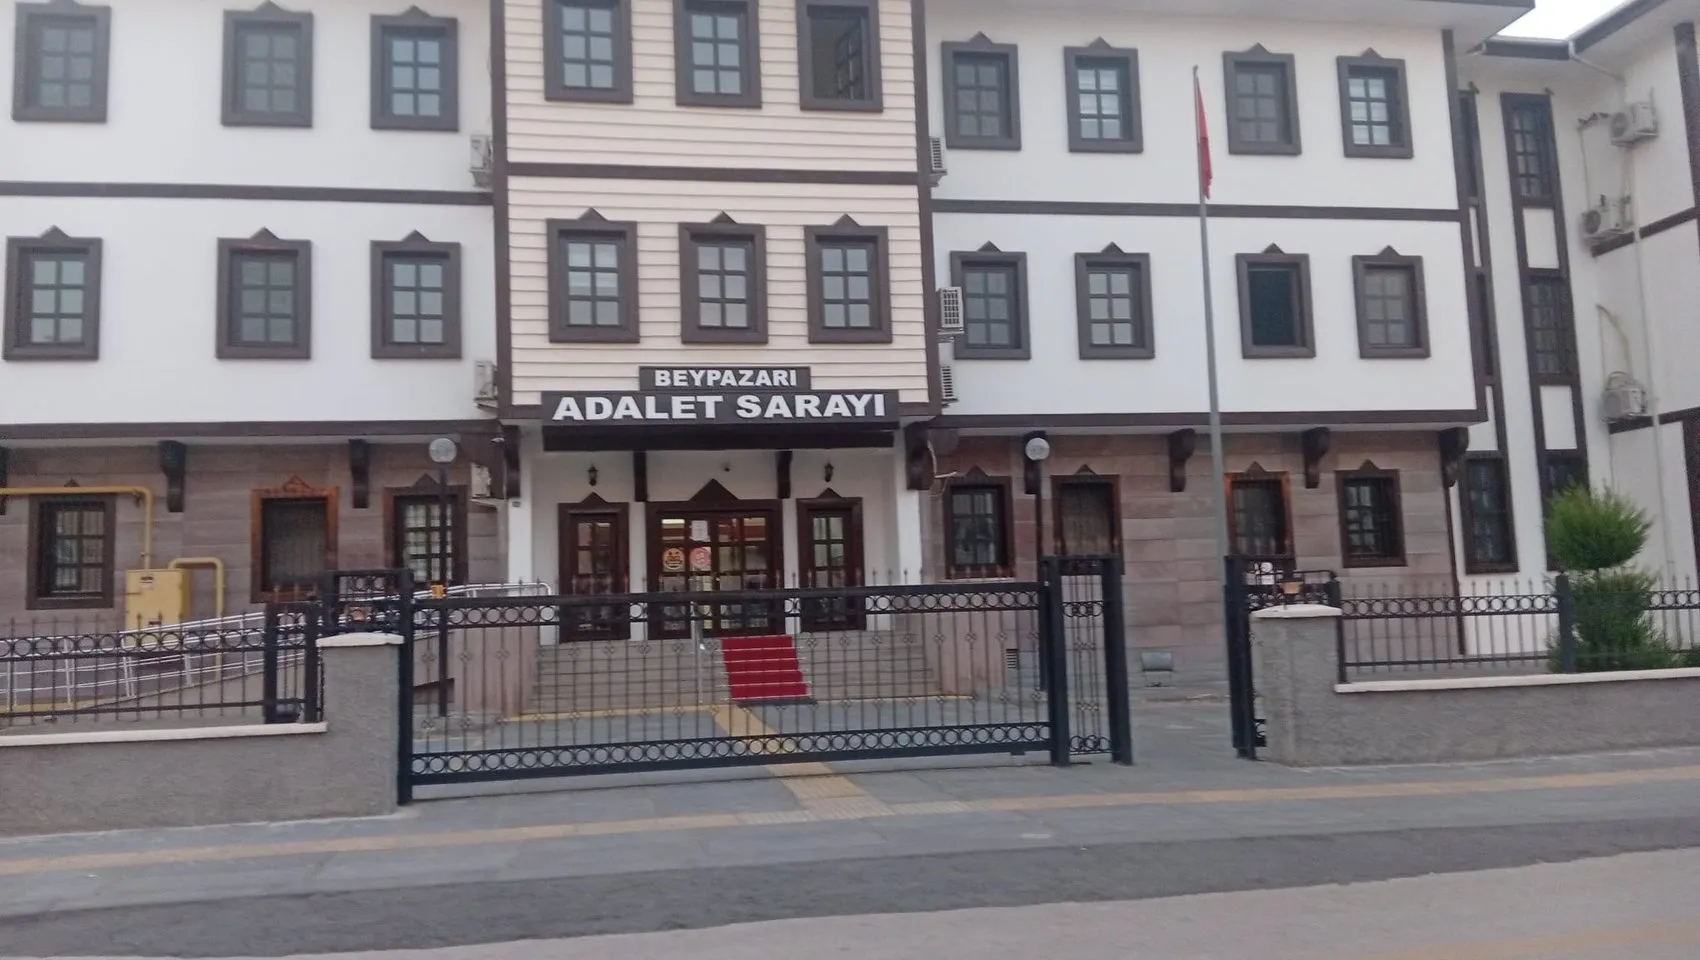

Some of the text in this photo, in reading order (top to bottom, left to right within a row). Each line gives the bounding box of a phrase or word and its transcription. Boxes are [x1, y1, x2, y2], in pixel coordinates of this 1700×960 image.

[654, 369, 797, 387] BEYPAZARI
[552, 393, 886, 421] ADALET SARAYI
